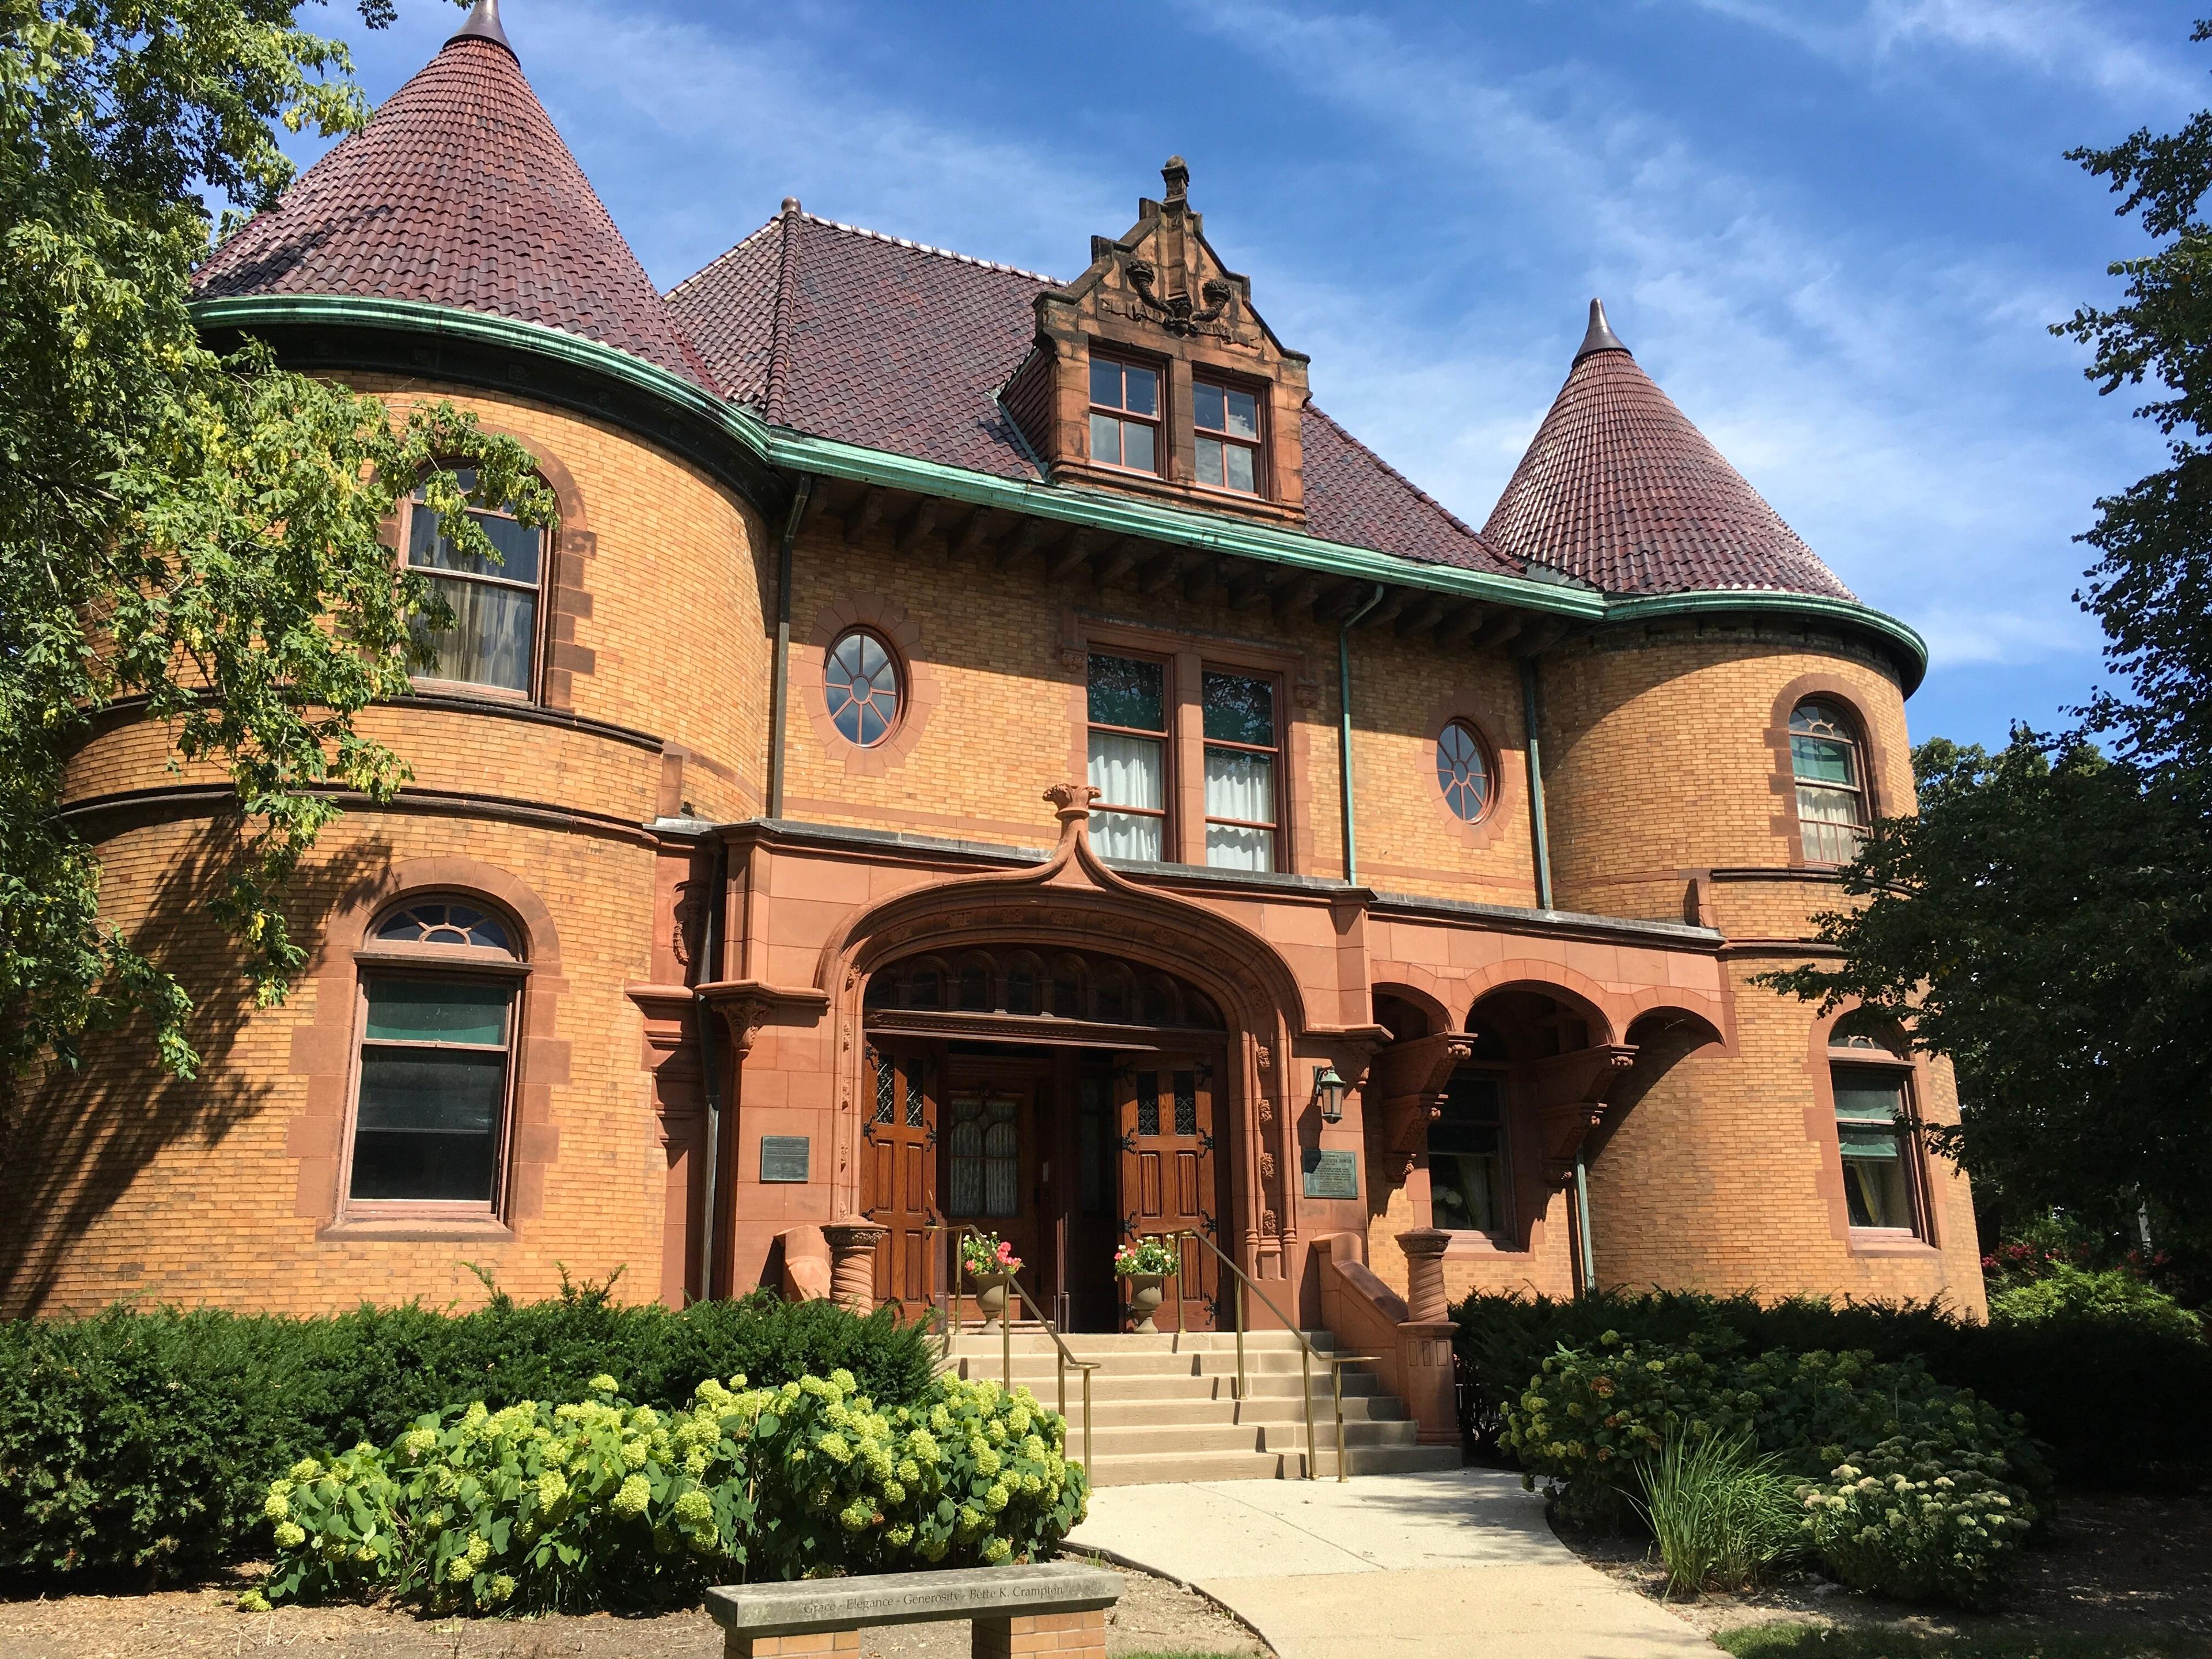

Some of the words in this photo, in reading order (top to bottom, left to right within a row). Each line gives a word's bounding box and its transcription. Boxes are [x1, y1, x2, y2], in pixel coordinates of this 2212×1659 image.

[804, 1602, 835, 1613] Grace
[847, 1598, 893, 1611] Elegance
[904, 1590, 960, 1605] Generosity
[969, 1589, 995, 1599] Bette
[999, 1587, 1010, 1598] K.
[1013, 1585, 1063, 1599] Crampton
